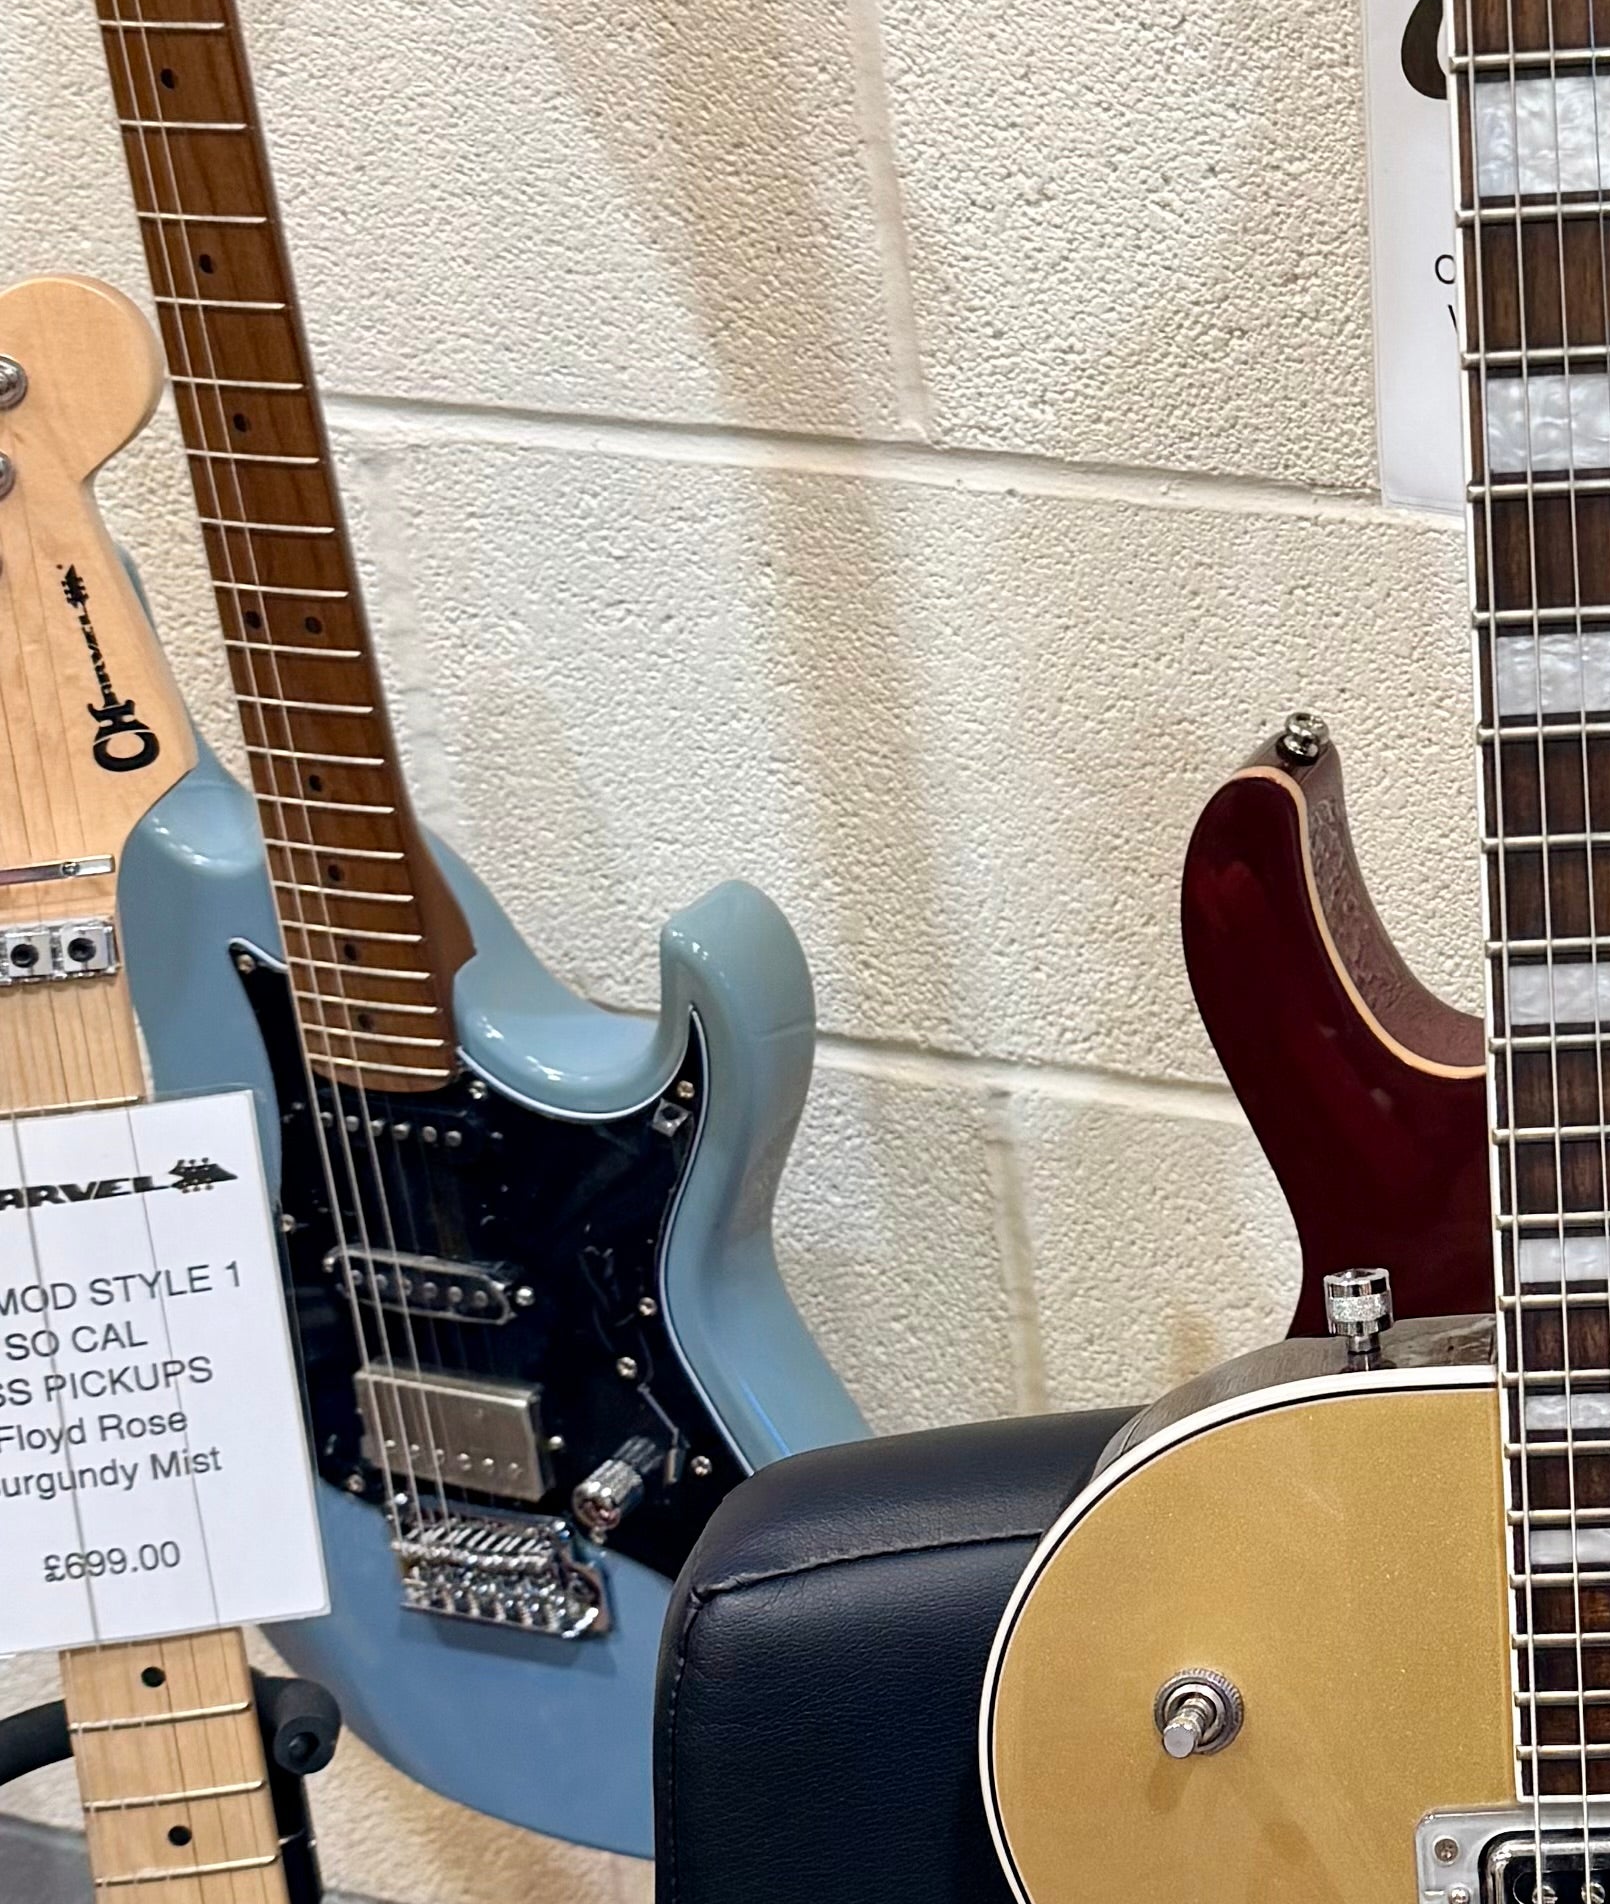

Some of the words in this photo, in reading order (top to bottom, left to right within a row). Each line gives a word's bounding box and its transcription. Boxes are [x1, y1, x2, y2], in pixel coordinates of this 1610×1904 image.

[88, 1263, 213, 1307] STYLE
[225, 1260, 240, 1288] 1
[4, 1329, 60, 1361] SO
[71, 1320, 149, 1353] CAL
[43, 1356, 214, 1402] PICKUPS
[0, 1416, 87, 1454] Floyd
[98, 1410, 188, 1442] Rose
[0, 1458, 139, 1500] urgundy
[149, 1446, 223, 1480] Mist
[43, 1540, 181, 1582] £699.00
